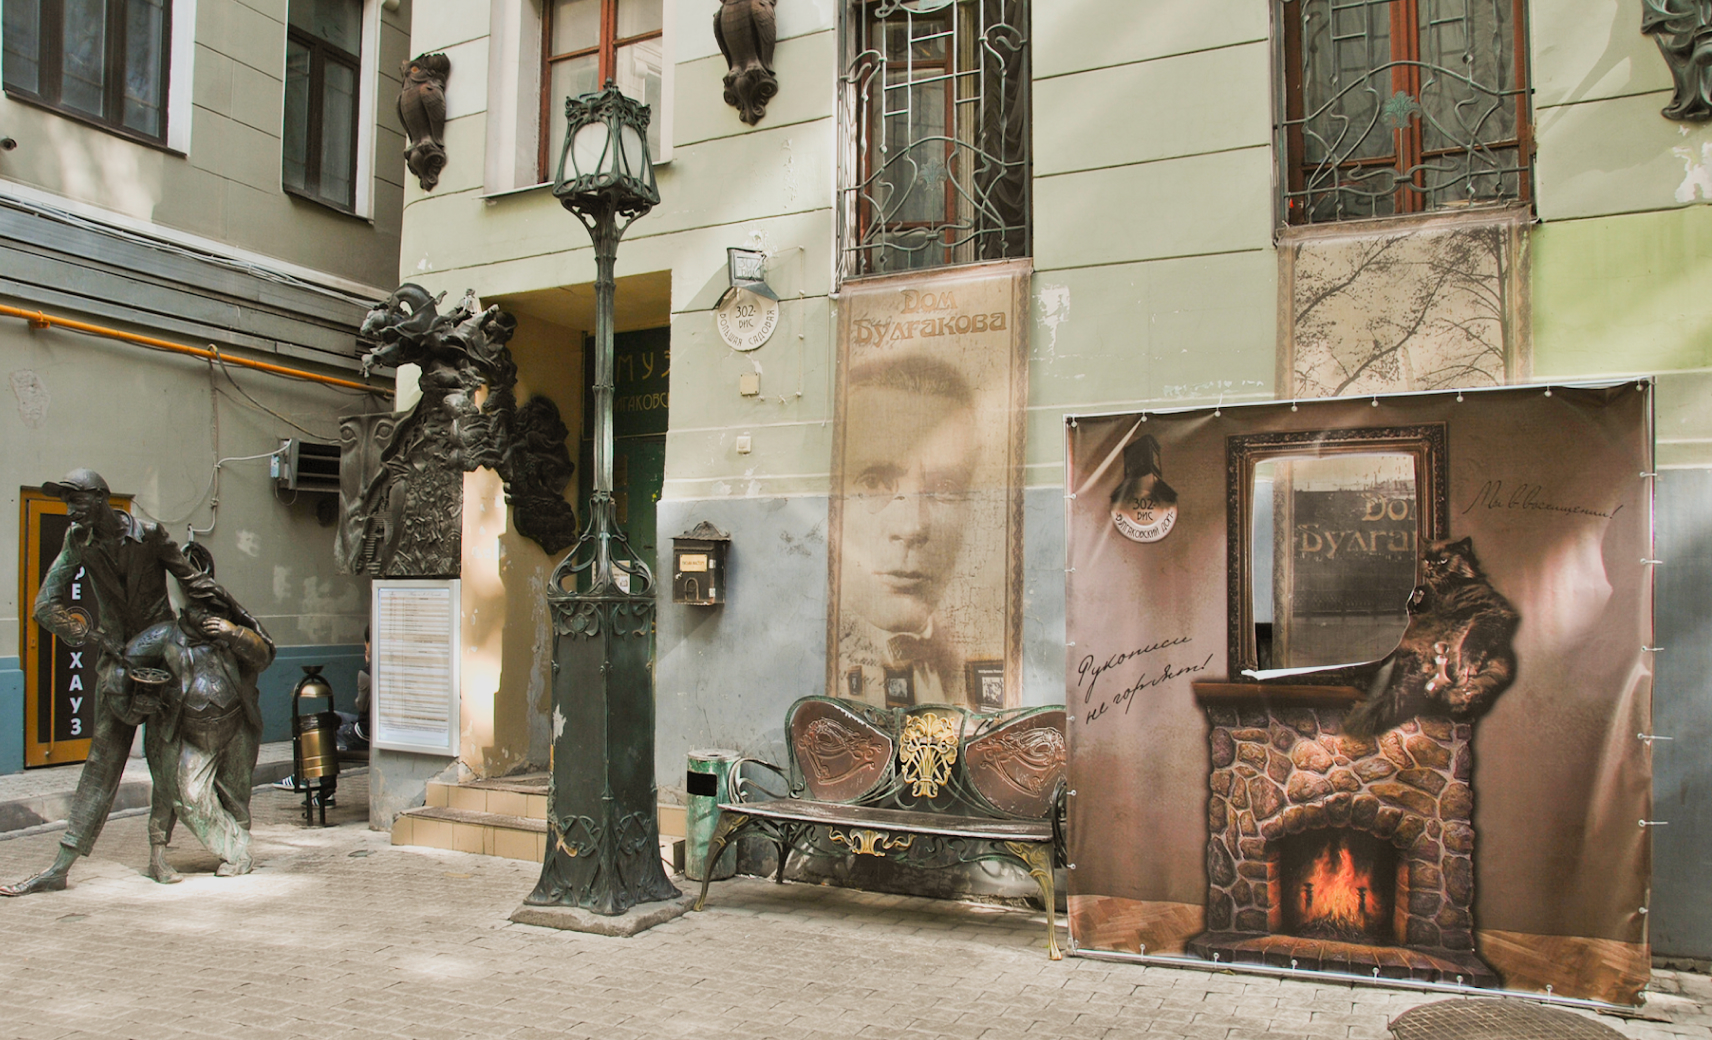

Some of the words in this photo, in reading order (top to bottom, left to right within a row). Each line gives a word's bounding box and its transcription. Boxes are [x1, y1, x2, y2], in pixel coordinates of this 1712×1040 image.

[900, 289, 958, 314] Дом
[719, 312, 743, 347] БОЛЬШАЯ
[747, 309, 775, 346] САДОВАЯ
[853, 311, 1007, 348] Булгакова
[1297, 523, 1417, 559] Булга
[1078, 636, 1192, 704] Рукописи
[1085, 702, 1109, 725] не
